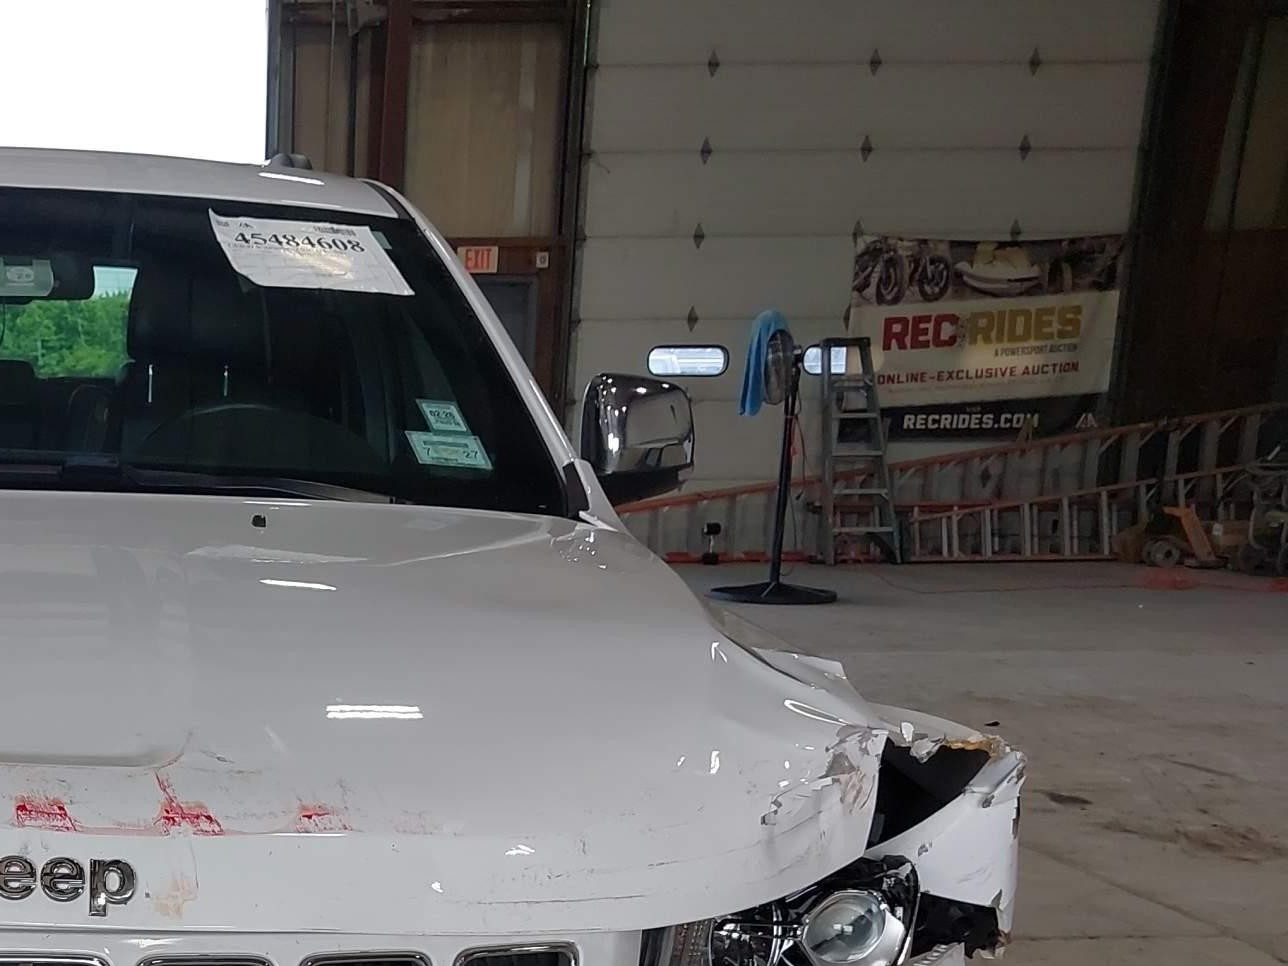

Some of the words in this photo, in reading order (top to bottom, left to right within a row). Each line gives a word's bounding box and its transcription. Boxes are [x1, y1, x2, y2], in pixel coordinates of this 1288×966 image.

[234, 232, 366, 254] 45484608
[465, 248, 492, 270] EXIT
[882, 313, 960, 350] REC
[969, 304, 1082, 344] RIDES
[1049, 342, 1078, 353] AUCTION
[877, 366, 1017, 385] ONLINE-EXCLUSIVE
[1022, 361, 1080, 376] AUCTION
